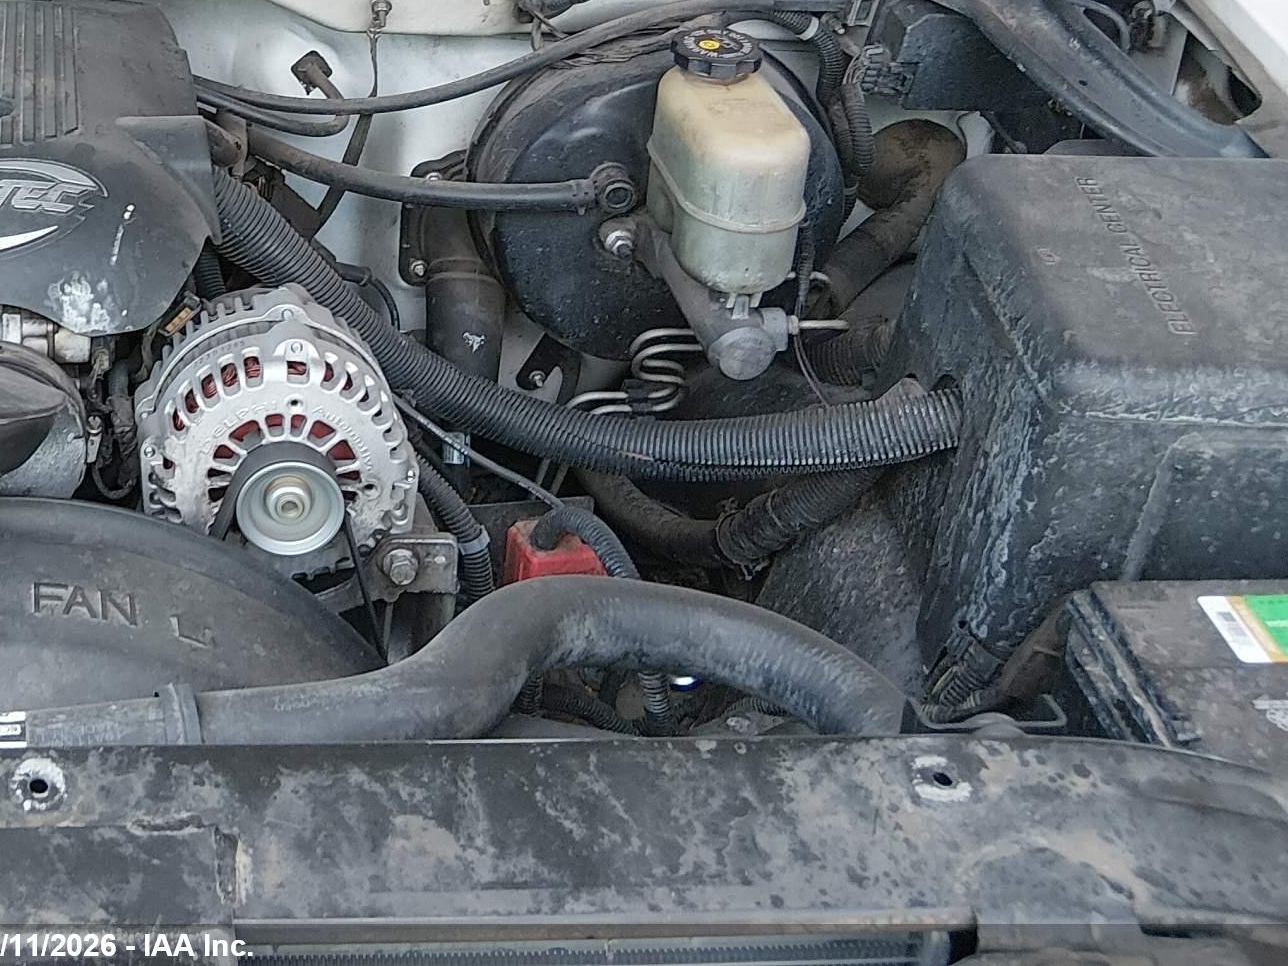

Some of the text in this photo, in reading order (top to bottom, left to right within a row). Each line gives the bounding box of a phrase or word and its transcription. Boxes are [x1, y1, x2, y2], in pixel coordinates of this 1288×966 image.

[1075, 177, 1198, 335] ELECTRICAL CENTER
[31, 582, 138, 627] FAN
